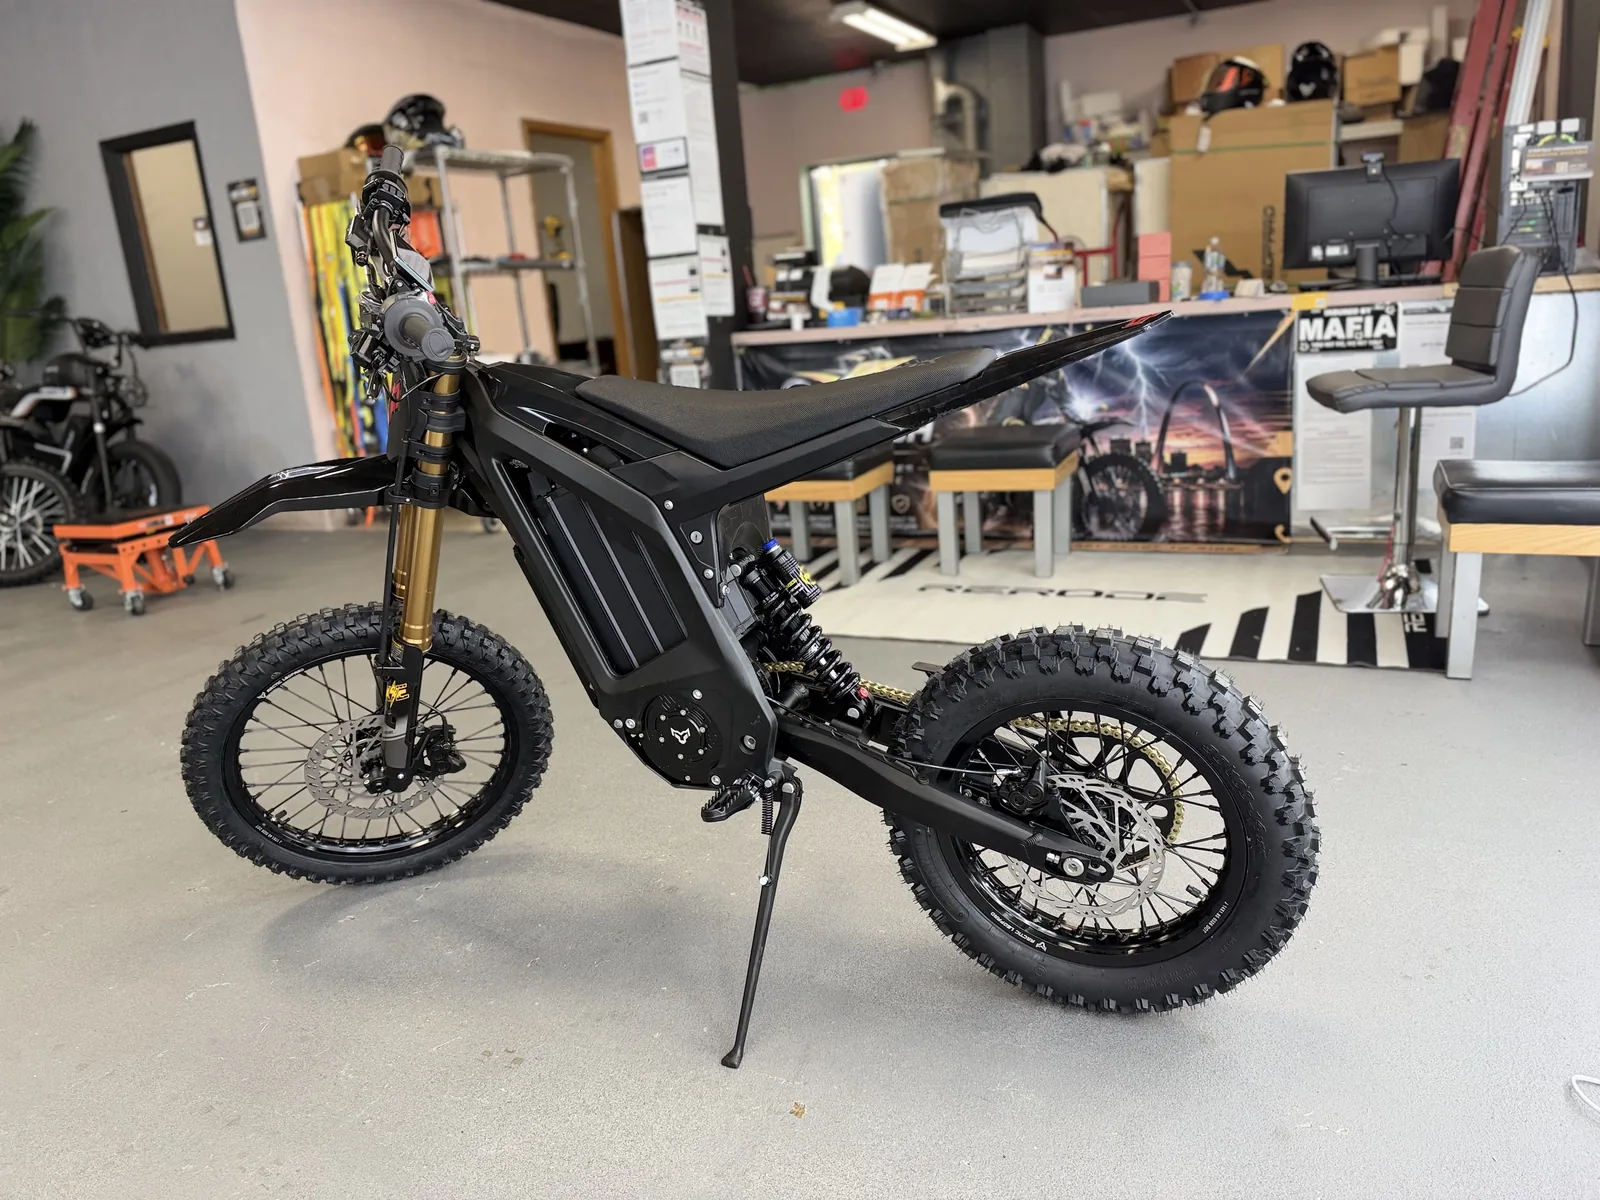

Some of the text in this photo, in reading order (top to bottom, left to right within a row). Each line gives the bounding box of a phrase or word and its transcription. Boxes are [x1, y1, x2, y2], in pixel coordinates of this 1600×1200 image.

[1299, 314, 1396, 342] MAFIA
[990, 911, 1036, 944] ARCTIC LEOPARD
